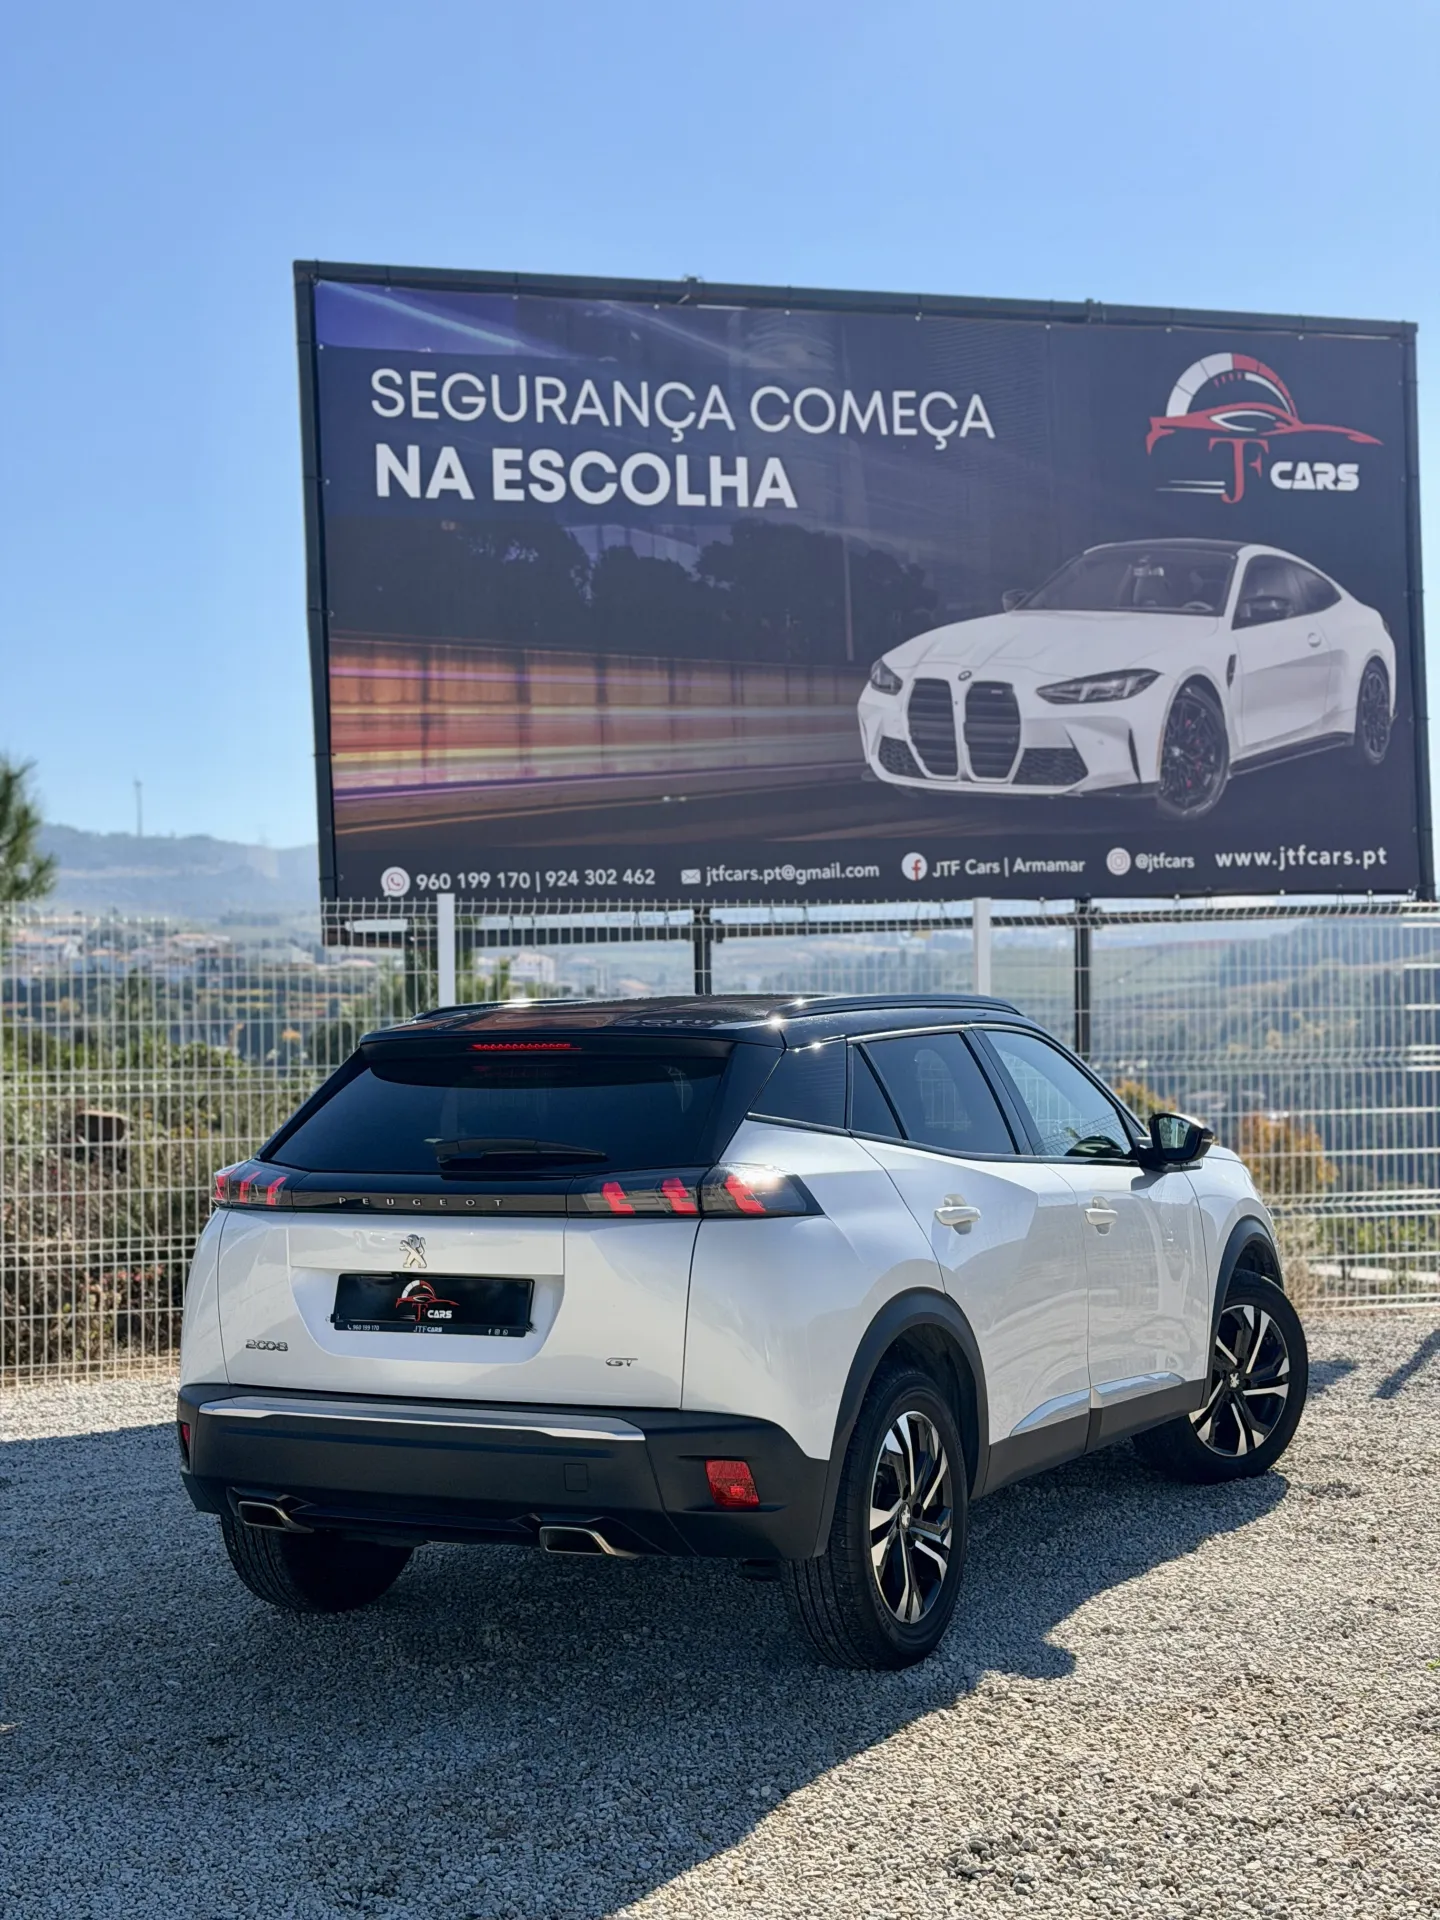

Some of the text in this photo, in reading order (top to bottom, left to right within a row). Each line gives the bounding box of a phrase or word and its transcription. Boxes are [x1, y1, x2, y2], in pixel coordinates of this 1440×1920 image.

[371, 368, 996, 450] SEGURANÇA COMEÇA
[375, 443, 798, 509] NA ESCOLHA
[1270, 461, 1360, 491] CARS
[932, 860, 960, 878] JTF
[965, 859, 1000, 875] Cars
[1013, 857, 1085, 873] Armamar
[1135, 852, 1195, 873] @jtfcars
[1215, 844, 1387, 871] www.jtfcars.pt
[416, 873, 451, 891] 960
[457, 872, 491, 889] 199
[497, 871, 531, 888] 170
[545, 870, 579, 887] 924
[585, 869, 618, 886] 302
[622, 868, 656, 885] 462
[706, 862, 880, 887] jtfcars.pt@gmail.com
[338, 1197, 502, 1207] PEUGEOT
[427, 1310, 452, 1319] CARS
[245, 1339, 288, 1351] 2008
[605, 1357, 638, 1367] GT
